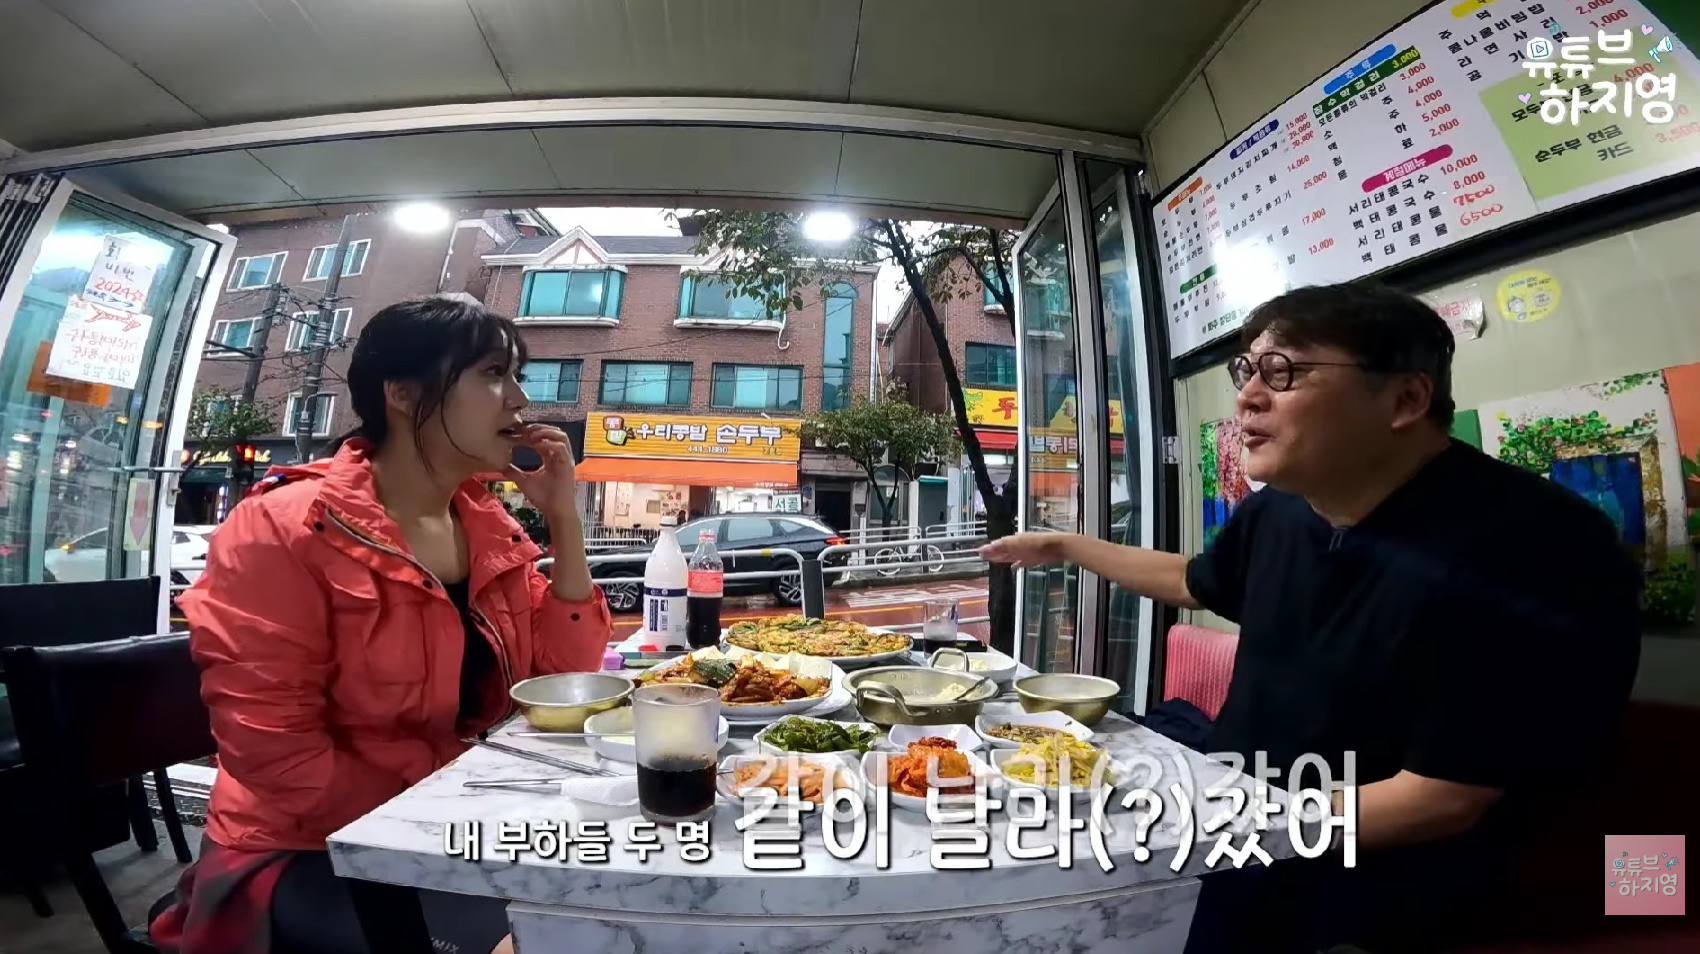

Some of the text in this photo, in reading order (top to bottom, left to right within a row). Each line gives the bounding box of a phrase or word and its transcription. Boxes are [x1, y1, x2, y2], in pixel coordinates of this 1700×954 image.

[1589, 9, 1628, 28] 1,000
[1392, 49, 1418, 69] 3,000
[1400, 62, 1426, 81] 3,000
[1422, 103, 1451, 123] 5,000
[1429, 118, 1459, 138] 2,000
[1535, 124, 1623, 163] 순두부 현금
[1596, 141, 1634, 161] 카드
[1440, 154, 1478, 175] 10,000
[1303, 171, 1328, 190] 25,000
[1453, 171, 1486, 190] 8,000
[1460, 203, 1504, 226] 6500
[1308, 238, 1335, 255] 13,000
[636, 422, 782, 446] 우리콩밥 손두부
